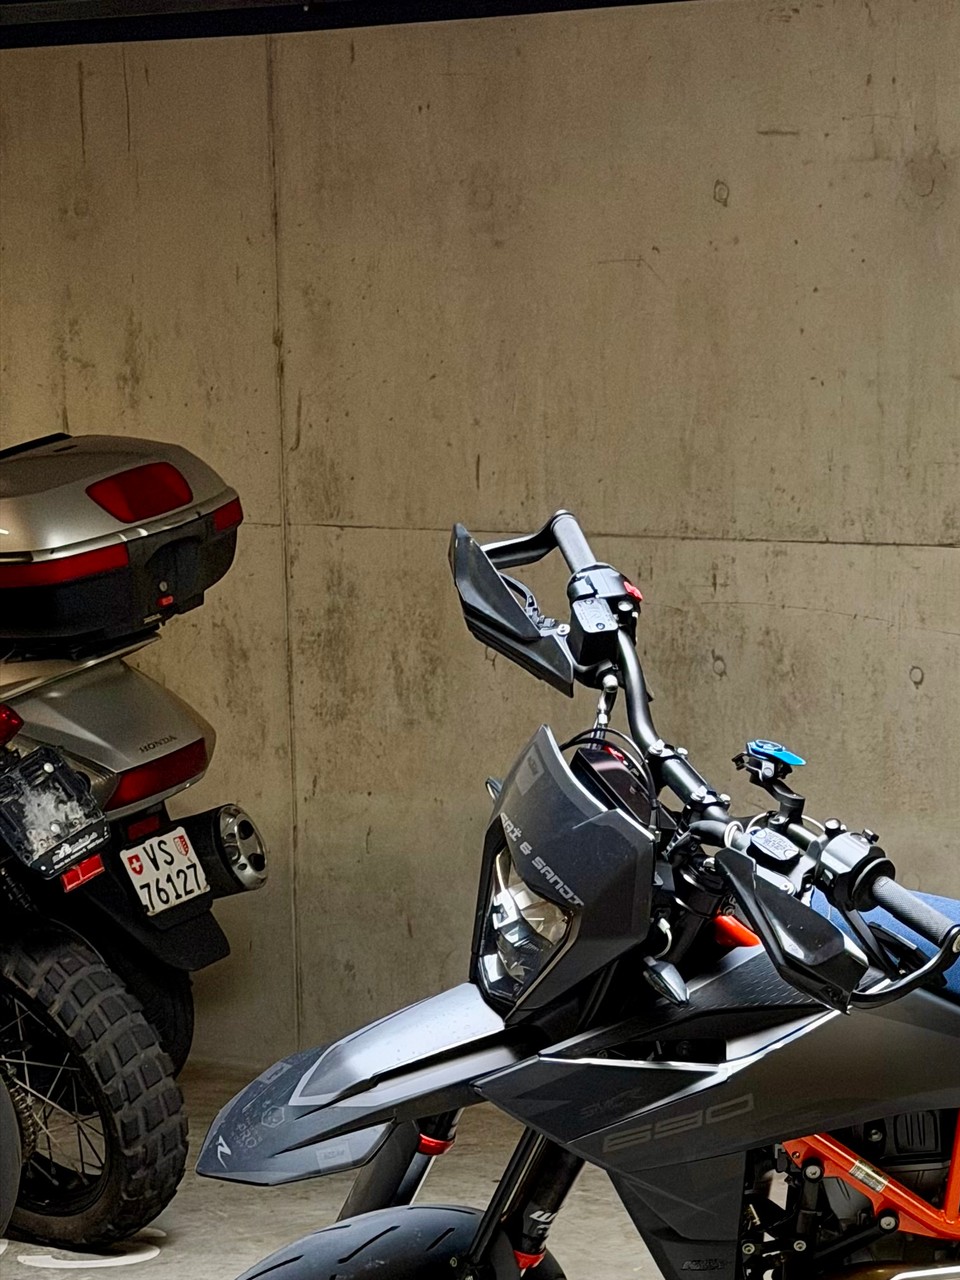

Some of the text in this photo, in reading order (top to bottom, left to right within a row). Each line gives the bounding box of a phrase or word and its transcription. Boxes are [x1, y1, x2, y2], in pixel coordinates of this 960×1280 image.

[138, 734, 179, 754] HONDA
[143, 840, 175, 872] VS
[139, 862, 202, 911] 76127
[603, 1093, 755, 1153] 690
